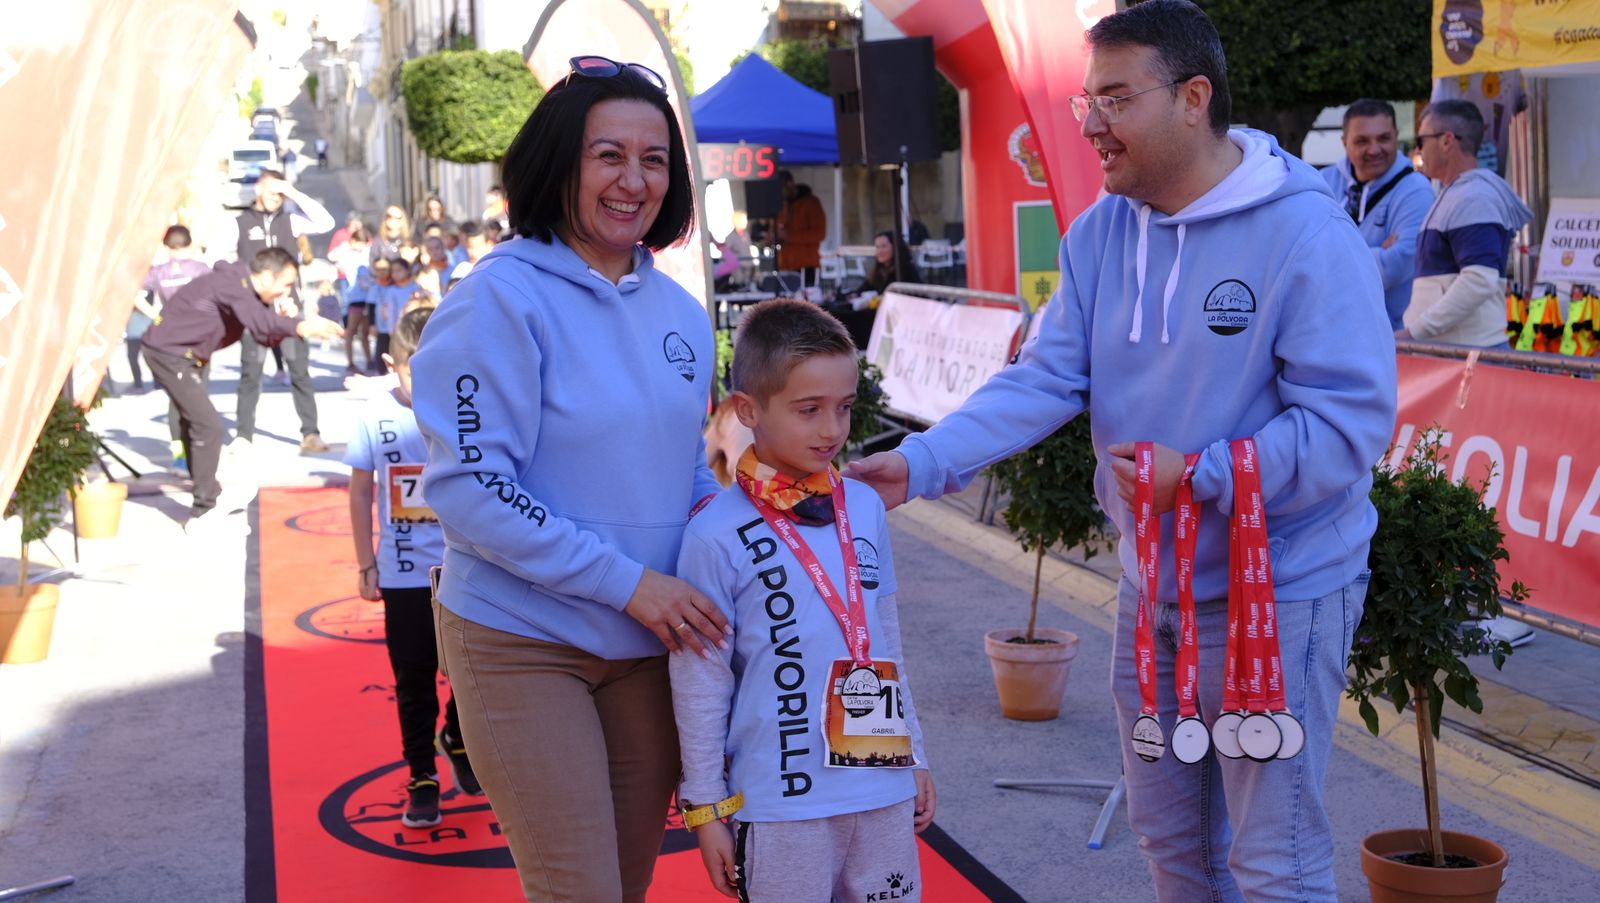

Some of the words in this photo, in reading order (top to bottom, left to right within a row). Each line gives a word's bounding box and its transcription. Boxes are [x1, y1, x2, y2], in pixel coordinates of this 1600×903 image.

[379, 419, 397, 445] LA
[736, 517, 778, 565] LA
[758, 564, 813, 798] POLVORILLA
[871, 727, 896, 735] GABRIEL
[394, 827, 467, 846] LA
[866, 881, 914, 903] KELME
